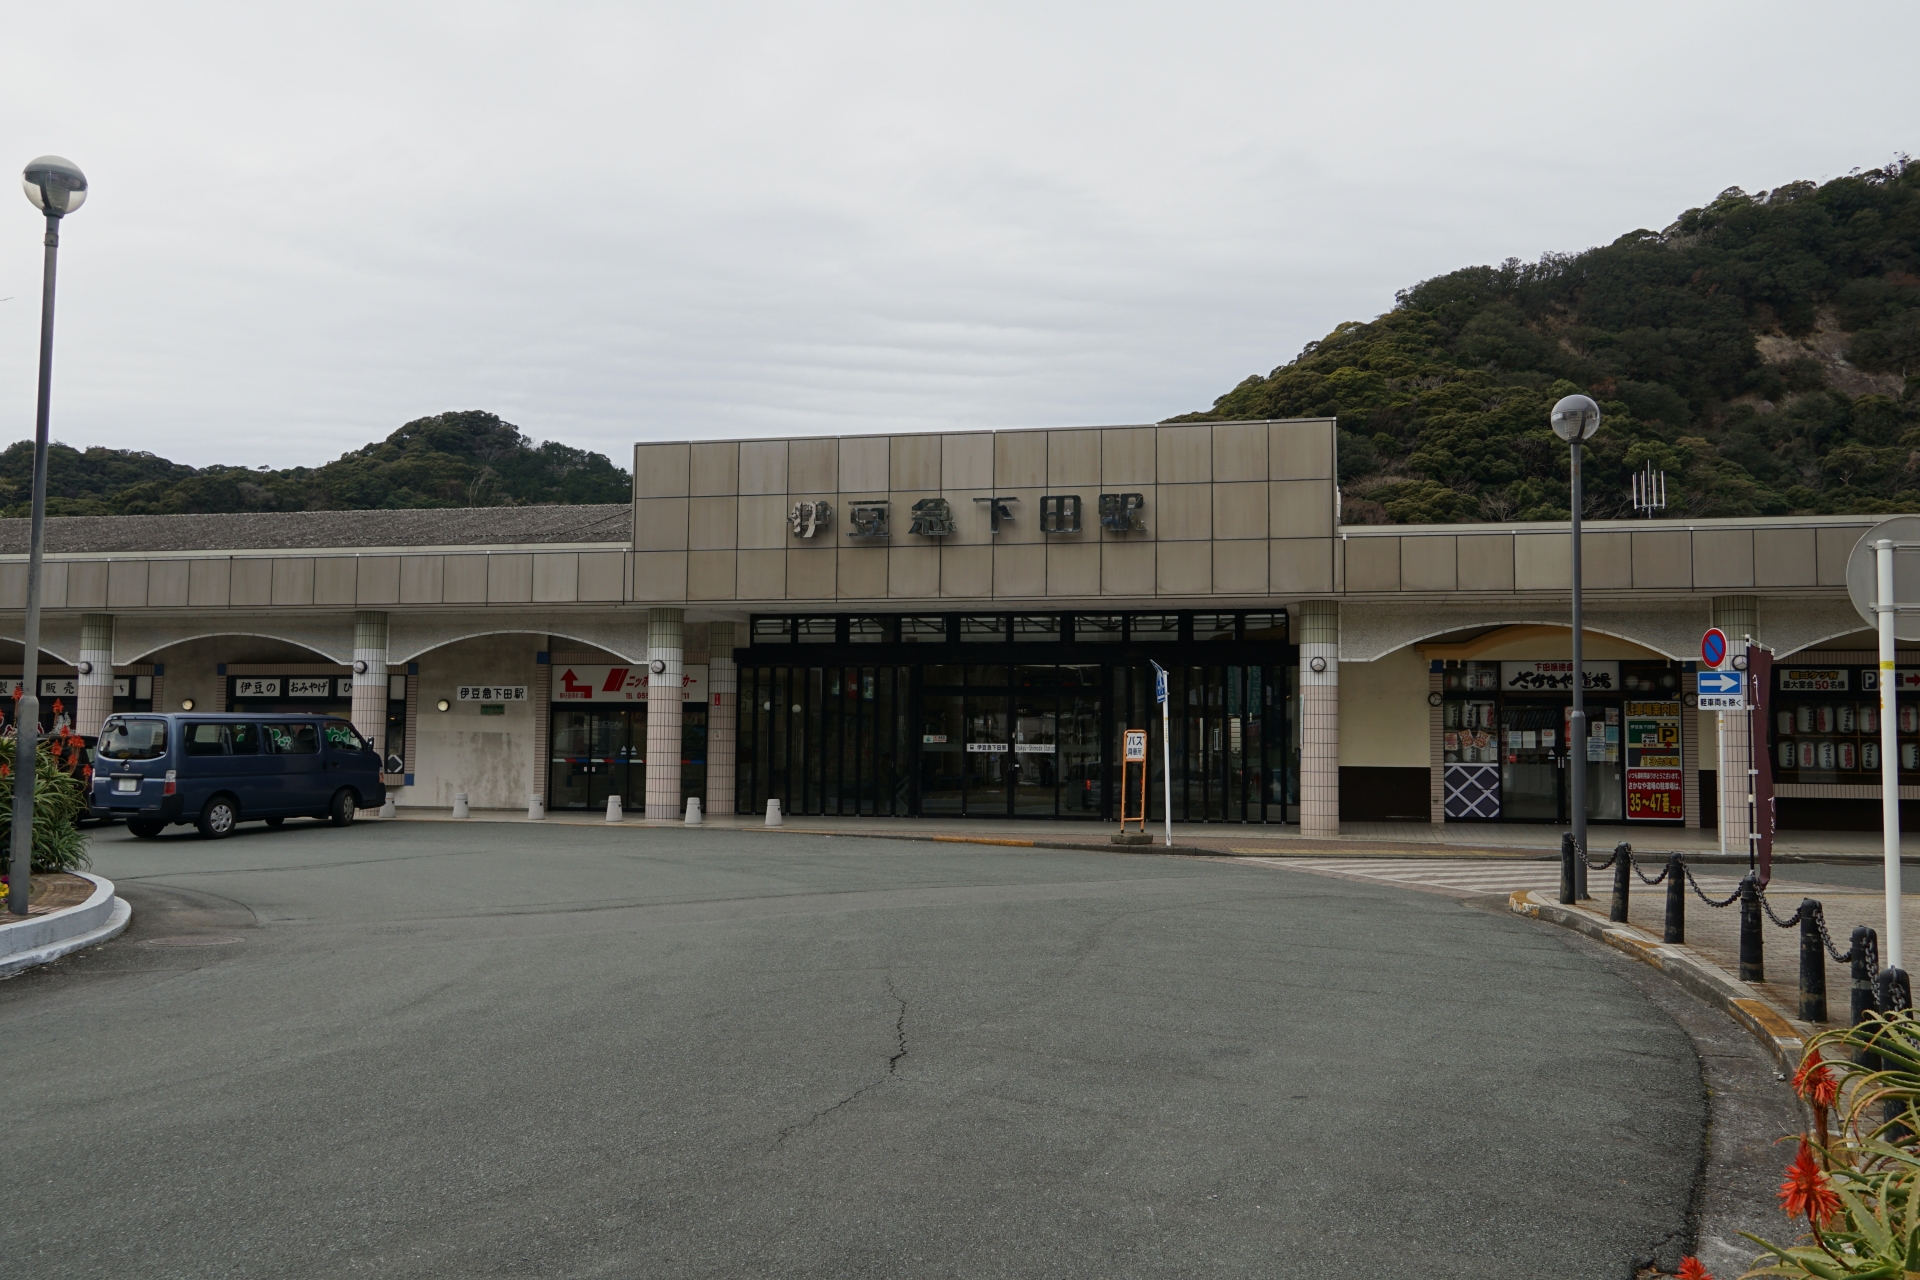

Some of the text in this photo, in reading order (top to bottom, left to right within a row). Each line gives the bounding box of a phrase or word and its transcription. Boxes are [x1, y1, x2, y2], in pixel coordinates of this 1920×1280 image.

[789, 494, 1147, 538] 伊豆急下田駅
[1509, 671, 1612, 689] さかなや道場
[1783, 680, 1845, 690] 最大宴会50名様
[45, 681, 75, 694] 販売
[240, 681, 276, 694] 伊豆の
[290, 681, 328, 694] おみやげ
[460, 687, 524, 699] 伊豆急下田駅
[1626, 702, 1679, 715] 駐車場案内図
[1700, 698, 1741, 706] 軽車両を除く
[1128, 736, 1142, 745] バス
[1662, 729, 1674, 741] P
